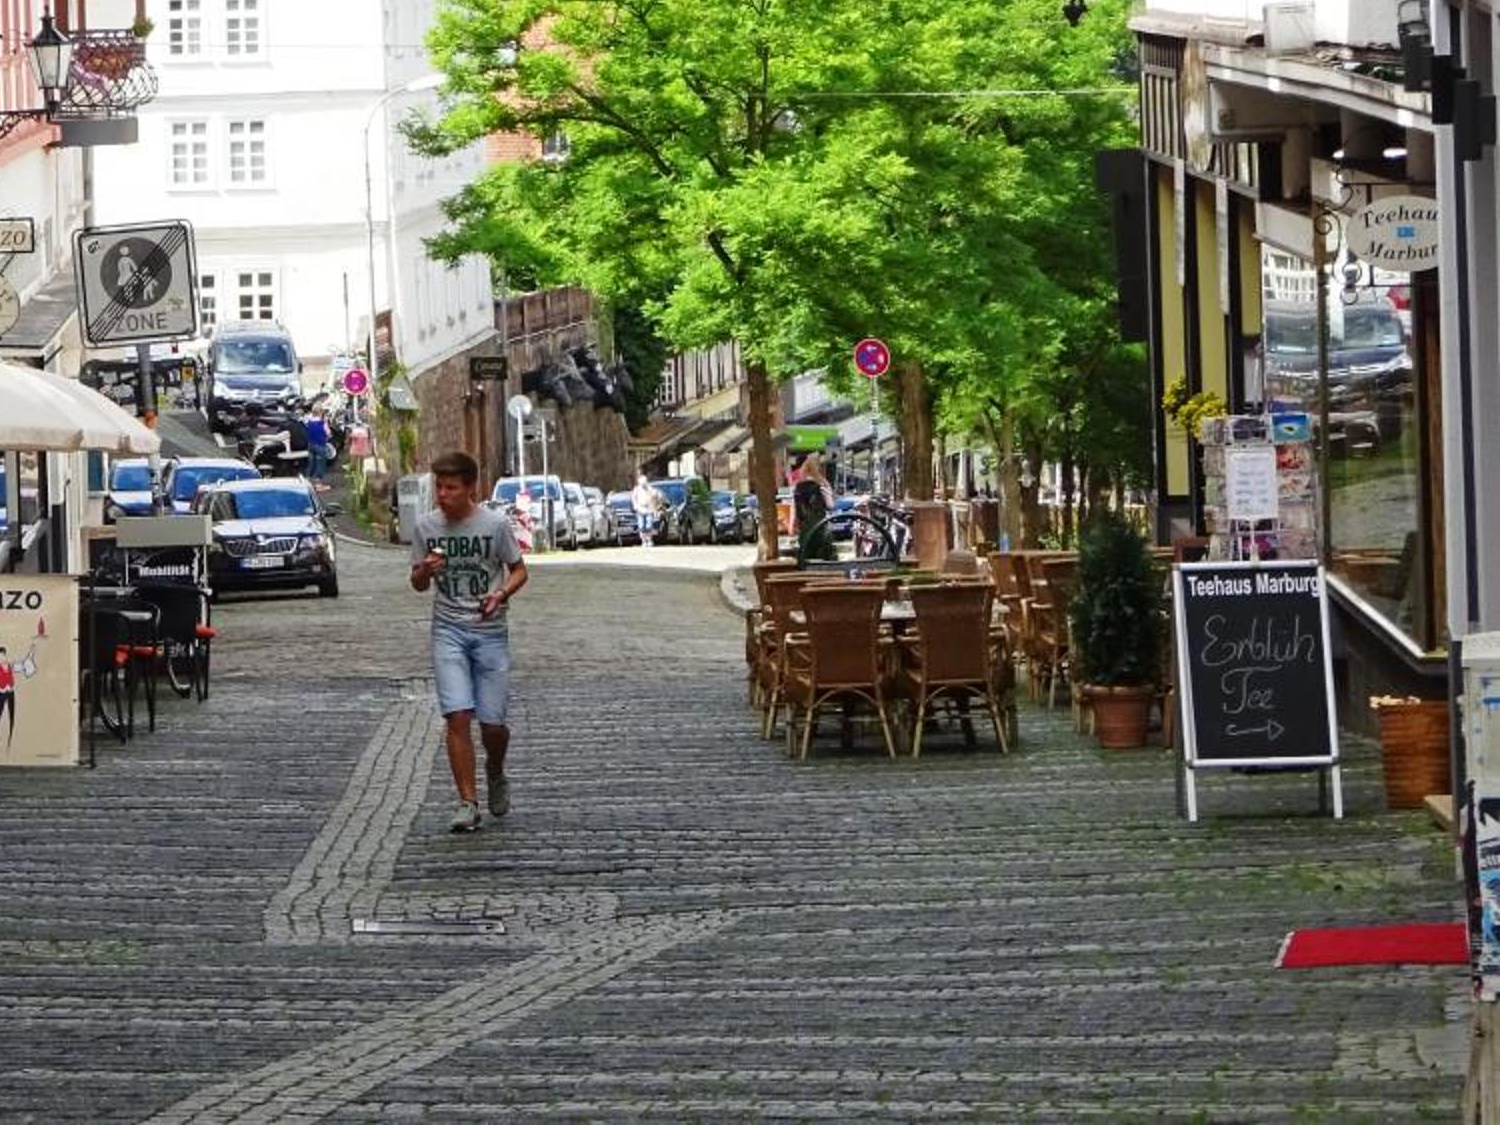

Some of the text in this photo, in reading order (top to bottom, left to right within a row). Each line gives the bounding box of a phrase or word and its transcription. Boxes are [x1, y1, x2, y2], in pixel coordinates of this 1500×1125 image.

[1364, 205, 1438, 228] Teehau
[1364, 240, 1438, 260] Marbur
[114, 312, 167, 332] ZONE
[1187, 573, 1320, 597] Teehaus Marburg
[1221, 664, 1283, 714] Tee
